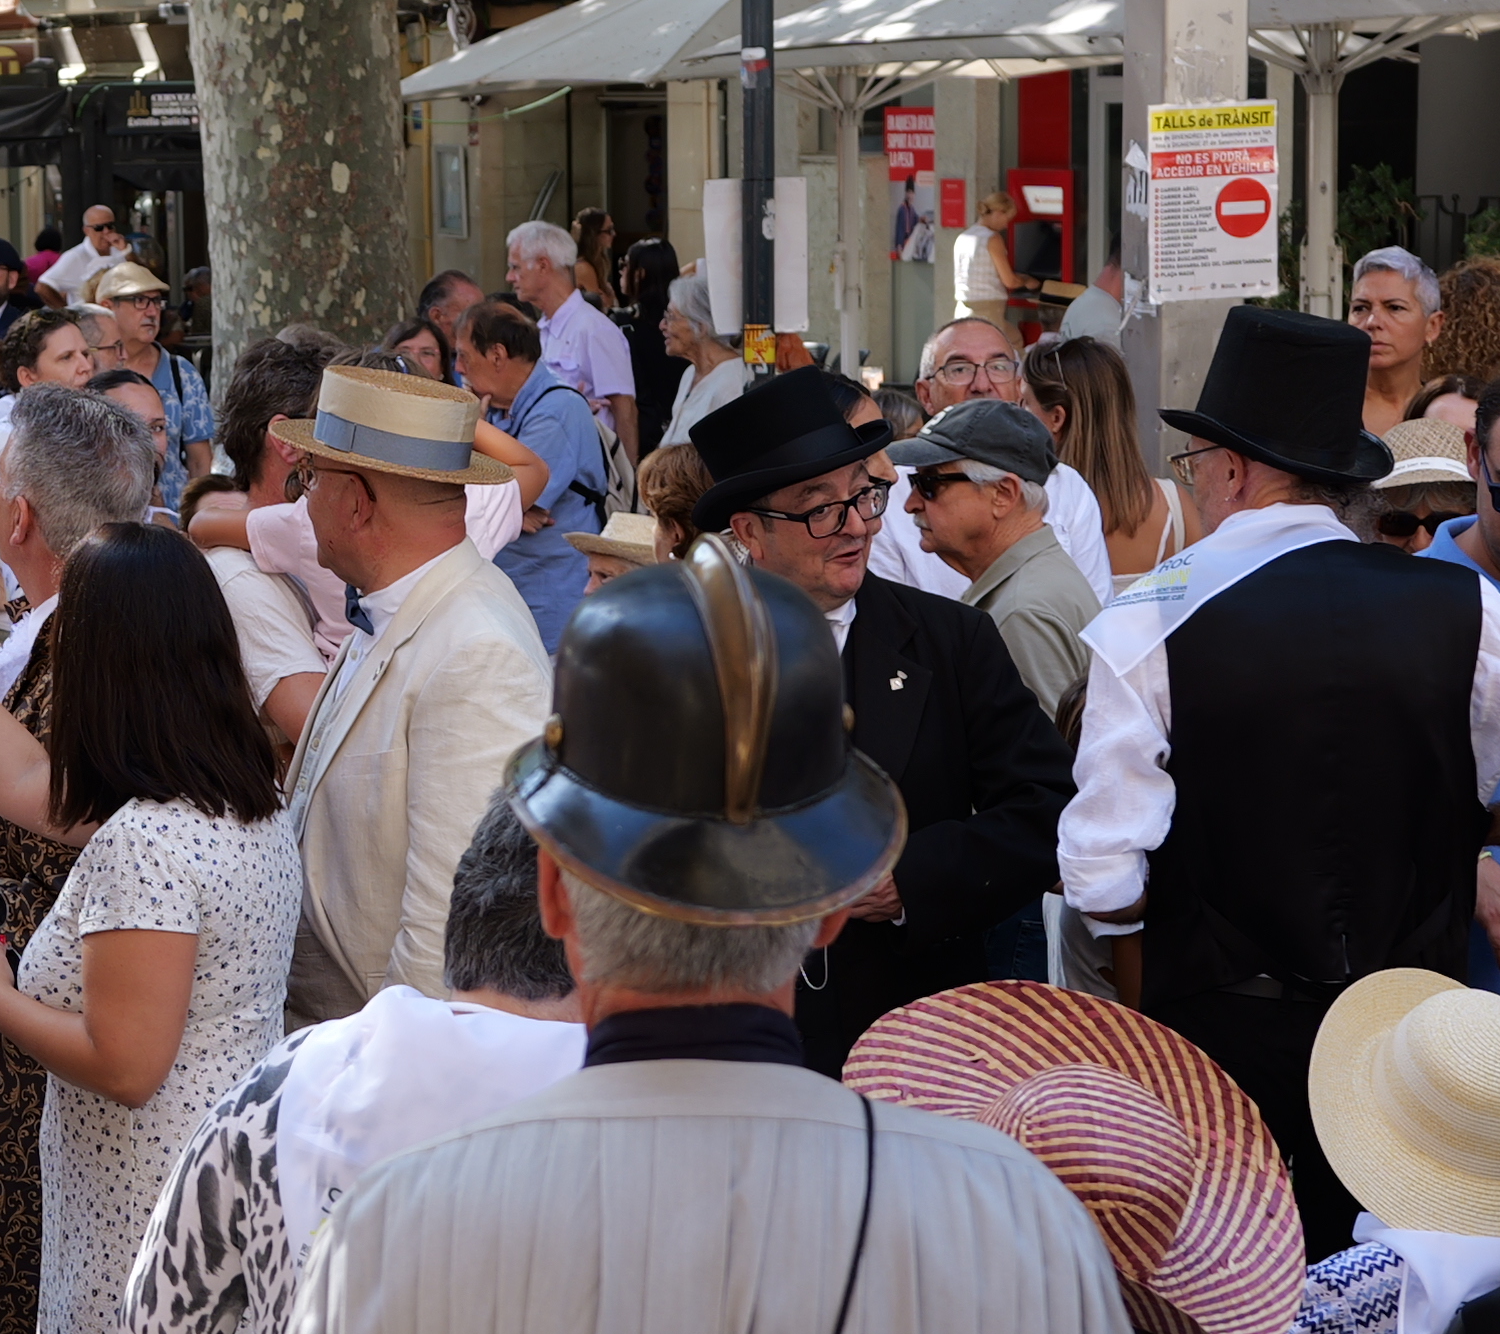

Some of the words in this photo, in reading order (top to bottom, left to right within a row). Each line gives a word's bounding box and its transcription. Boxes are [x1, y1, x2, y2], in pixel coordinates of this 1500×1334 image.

[1154, 115, 1196, 129] TALLS
[1198, 115, 1213, 127] de
[1215, 109, 1271, 126] TRÀNSIT
[1176, 154, 1193, 165] NO
[1195, 152, 1209, 164] ES
[1212, 149, 1250, 163] PODRÀ
[1156, 165, 1204, 178] ACCEDIR
[1206, 164, 1222, 175] EN
[1224, 161, 1271, 174] VEHICLE
